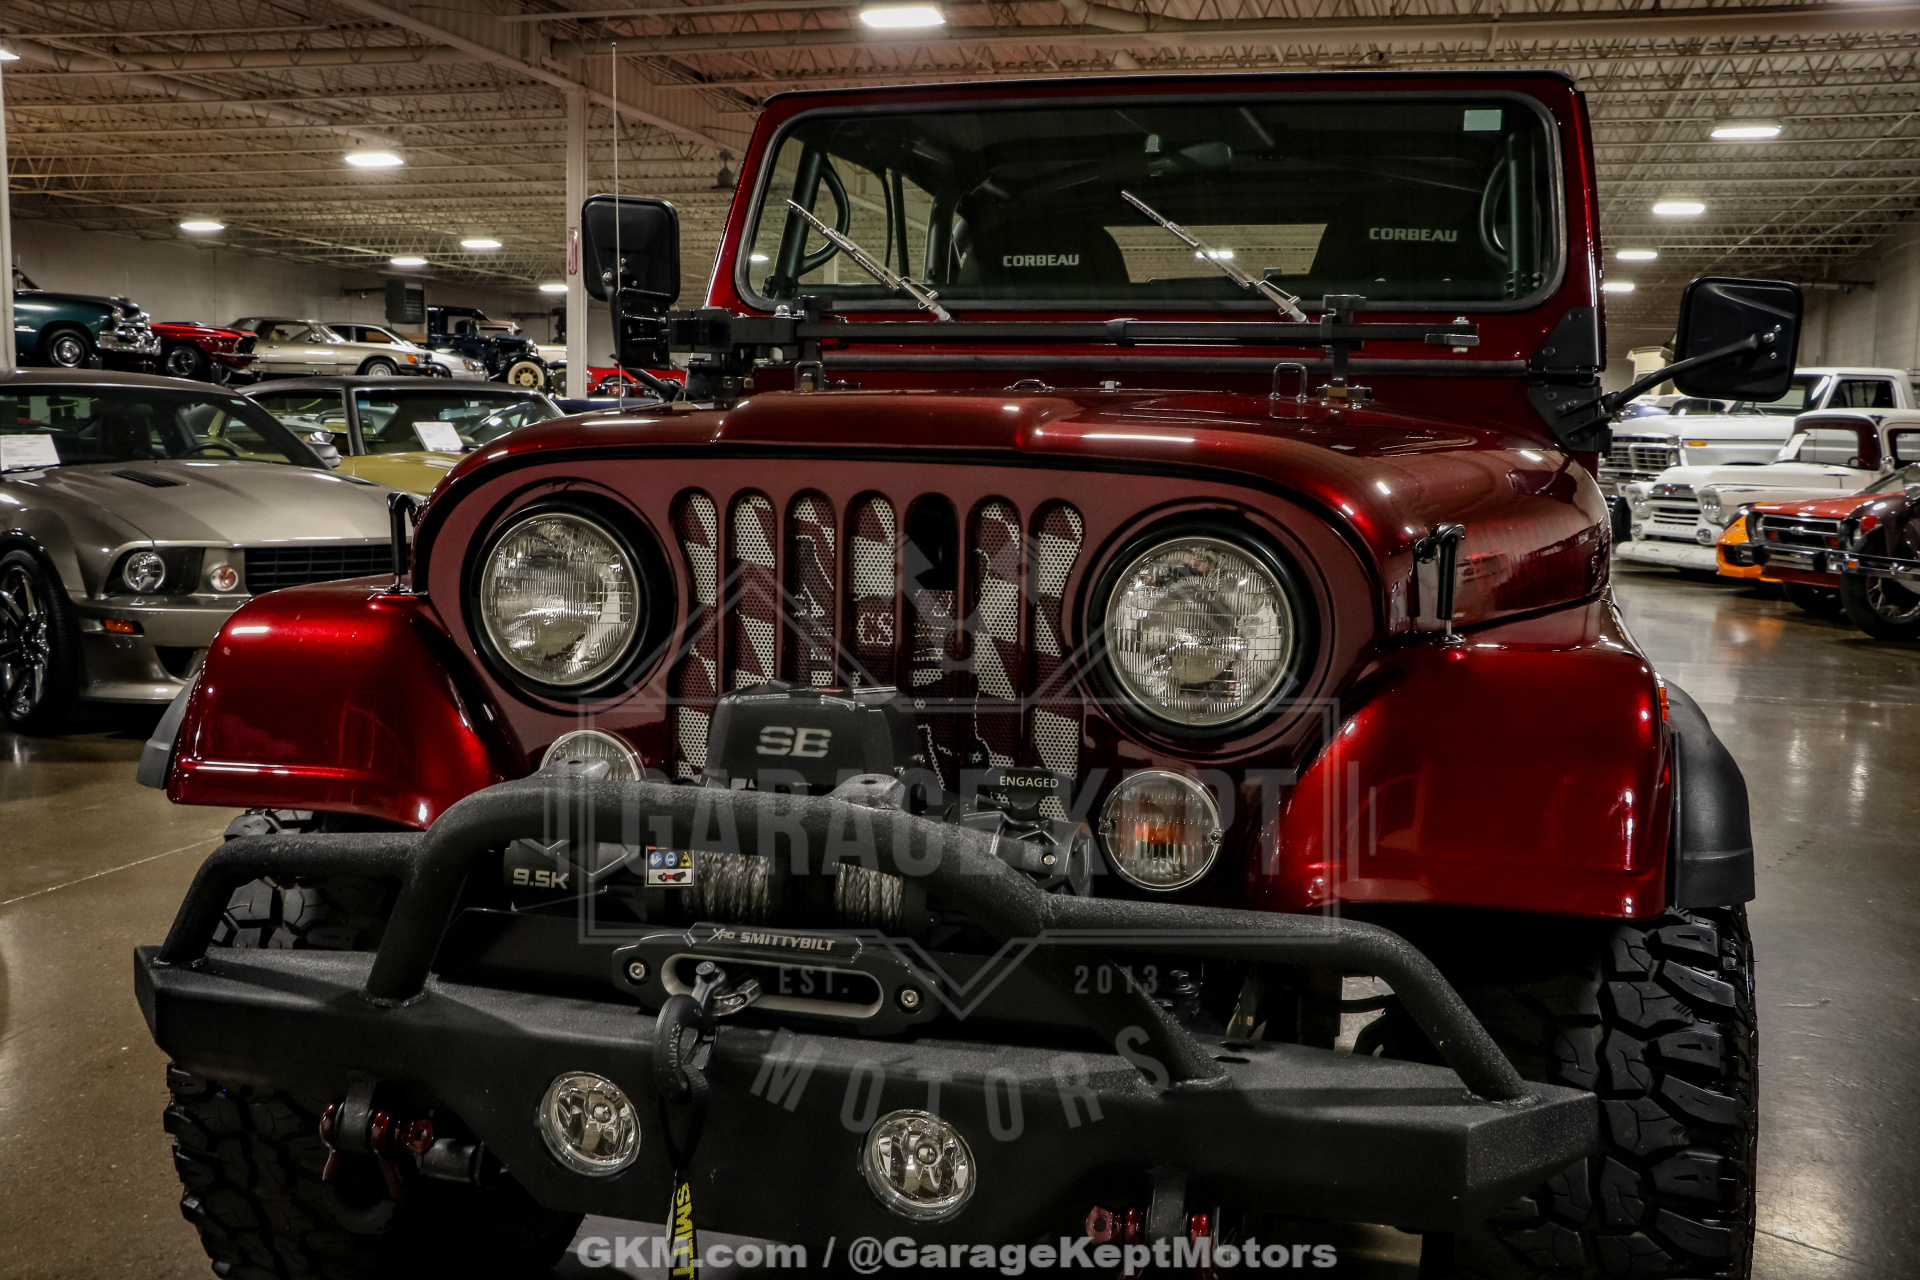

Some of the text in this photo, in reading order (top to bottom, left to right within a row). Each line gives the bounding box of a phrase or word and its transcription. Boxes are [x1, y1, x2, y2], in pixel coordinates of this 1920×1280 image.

[1369, 227, 1458, 243] CORBEAU
[1002, 254, 1080, 267] CORBEAU
[999, 775, 1060, 789] ENGAGED
[512, 868, 570, 890] 9.5K
[740, 931, 836, 952] SMITTYBILT
